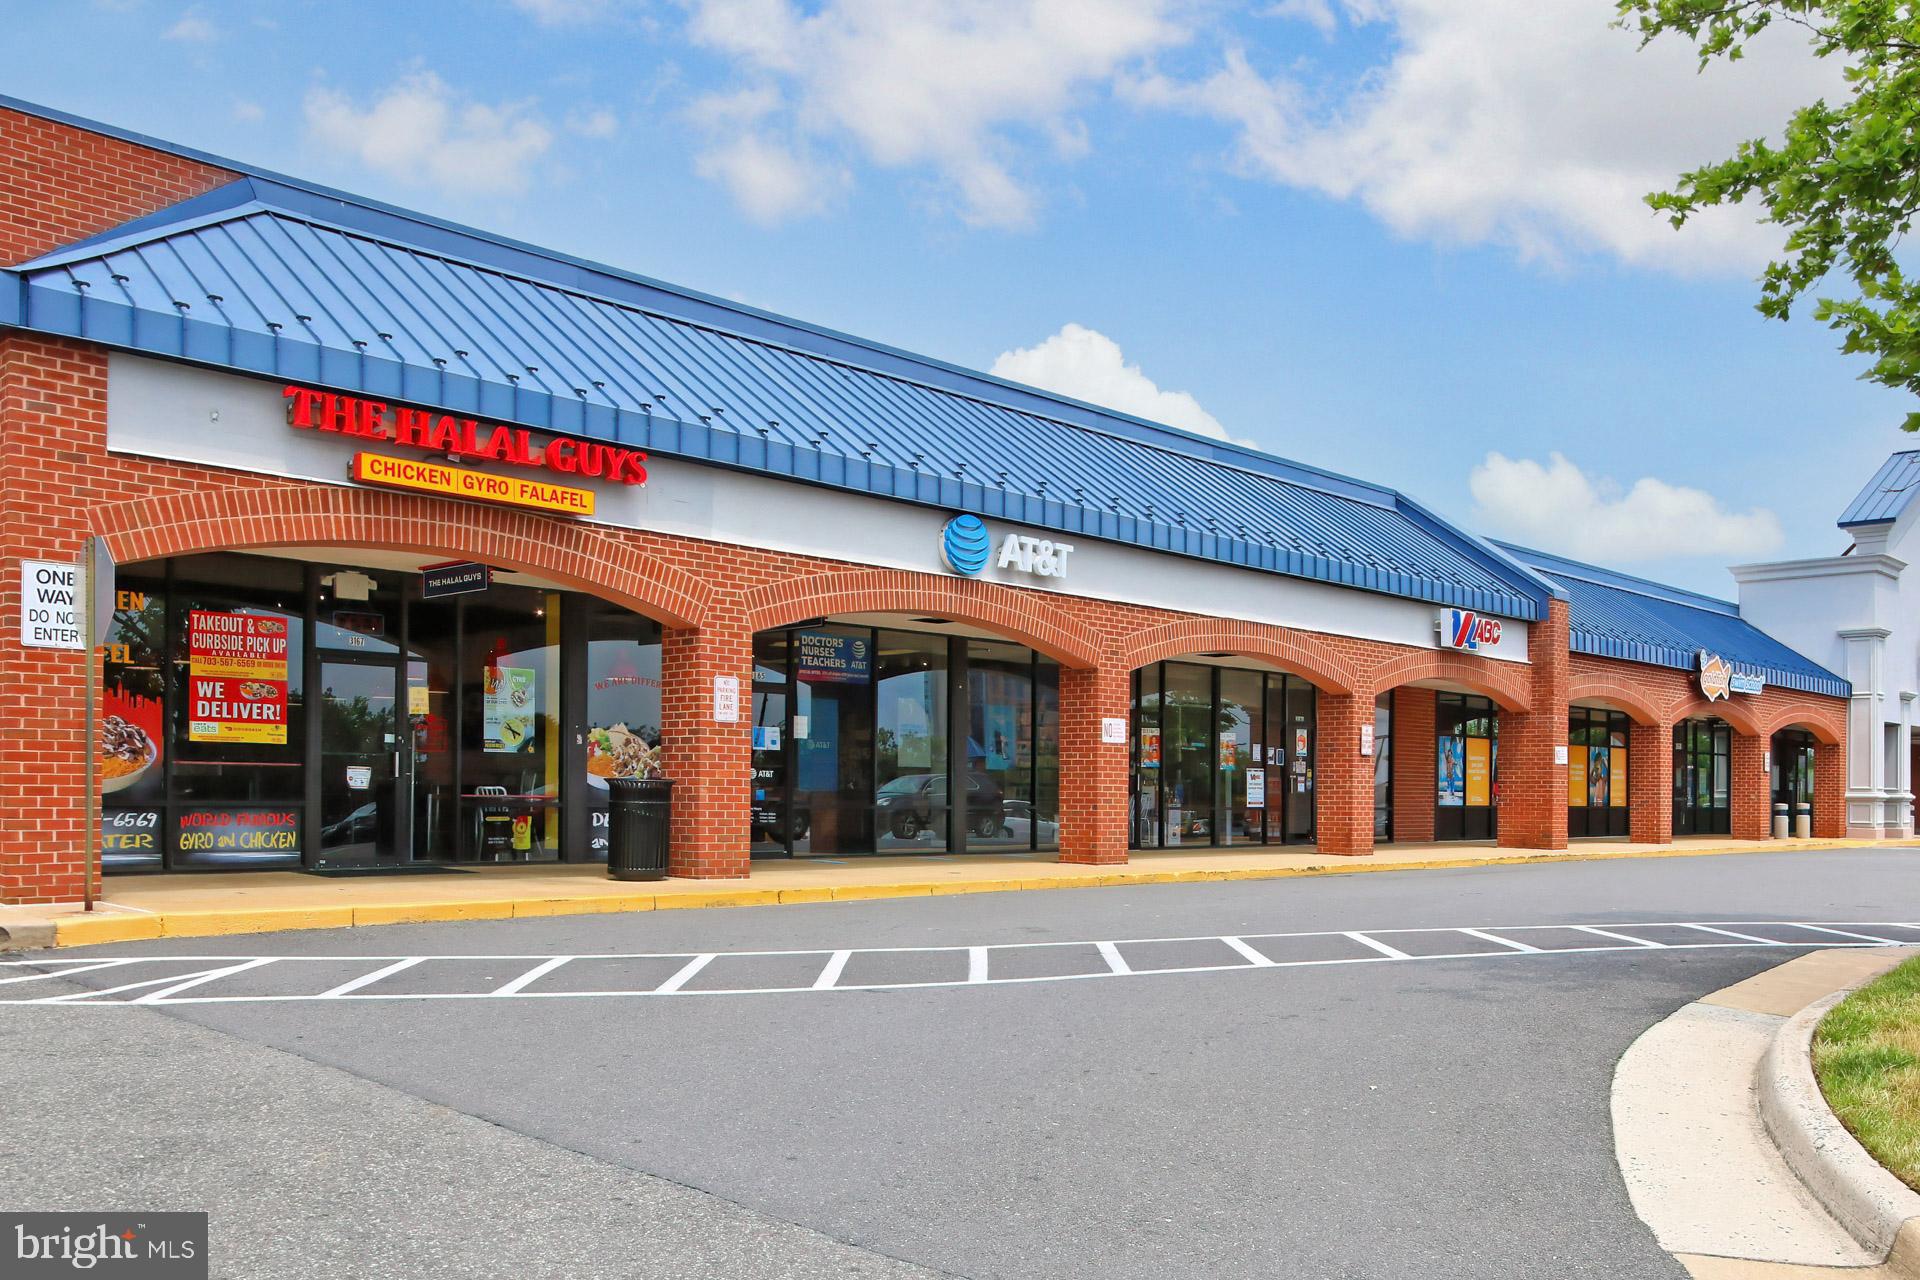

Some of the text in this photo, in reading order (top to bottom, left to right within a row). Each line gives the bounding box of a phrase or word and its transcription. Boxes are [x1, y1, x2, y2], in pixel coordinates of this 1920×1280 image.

[283, 385, 648, 486] THE HALAL GUYS
[370, 459, 588, 508] CHICKEN GYRO FALAFEL
[998, 533, 1074, 578] AT&T
[36, 569, 74, 586] ONE
[429, 573, 482, 587] THE HALAL GUYS
[37, 588, 73, 606] WAY
[29, 609, 75, 625] DO NO
[192, 614, 255, 634] TAKEOUT &
[34, 627, 79, 642] ENTER
[1472, 620, 1501, 645] ABC
[192, 632, 287, 653] CURBSIDE PICK UP
[801, 635, 843, 648] DOCTORS
[211, 650, 267, 659] AVAILABLE
[801, 646, 836, 657] NURSES
[801, 656, 847, 669] TEACHERS
[851, 661, 867, 670] AT&T
[197, 681, 225, 698] WE
[720, 694, 732, 703] FIRE
[197, 701, 281, 720] DELIVER!
[719, 703, 733, 711] LANE
[193, 724, 217, 733] eats
[1104, 723, 1113, 738] NO
[758, 770, 774, 778] AT&T
[102, 812, 157, 828] -6569
[180, 812, 296, 829] WORLD FAMOUS
[179, 830, 296, 850] GYRO and CHICKEN
